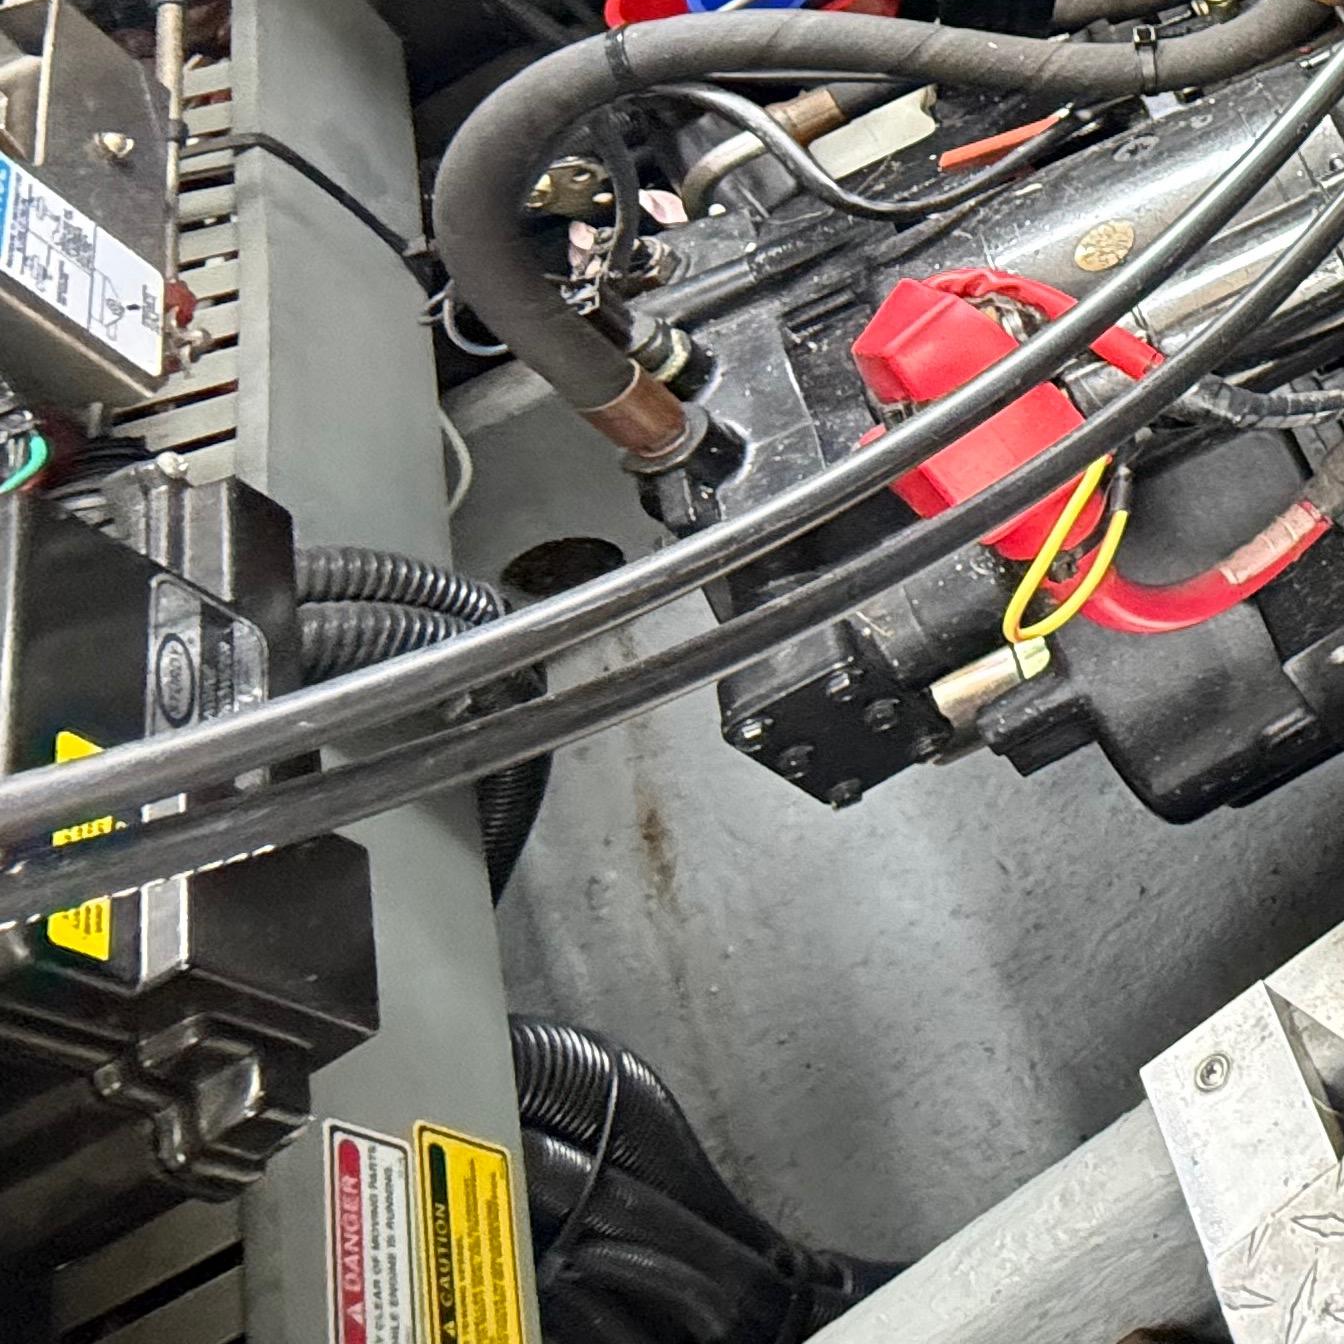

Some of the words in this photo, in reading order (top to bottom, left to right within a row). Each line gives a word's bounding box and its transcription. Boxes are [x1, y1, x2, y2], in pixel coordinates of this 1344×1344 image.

[368, 1146, 378, 1190] PARTS
[341, 1175, 361, 1292] DANGER
[370, 1194, 380, 1251] MOVING
[386, 1235, 396, 1247] IS
[371, 1257, 382, 1275] OF
[387, 1253, 399, 1307] ENGINE
[435, 1202, 453, 1307] CAUTION
[372, 1279, 383, 1331] CLEAR
